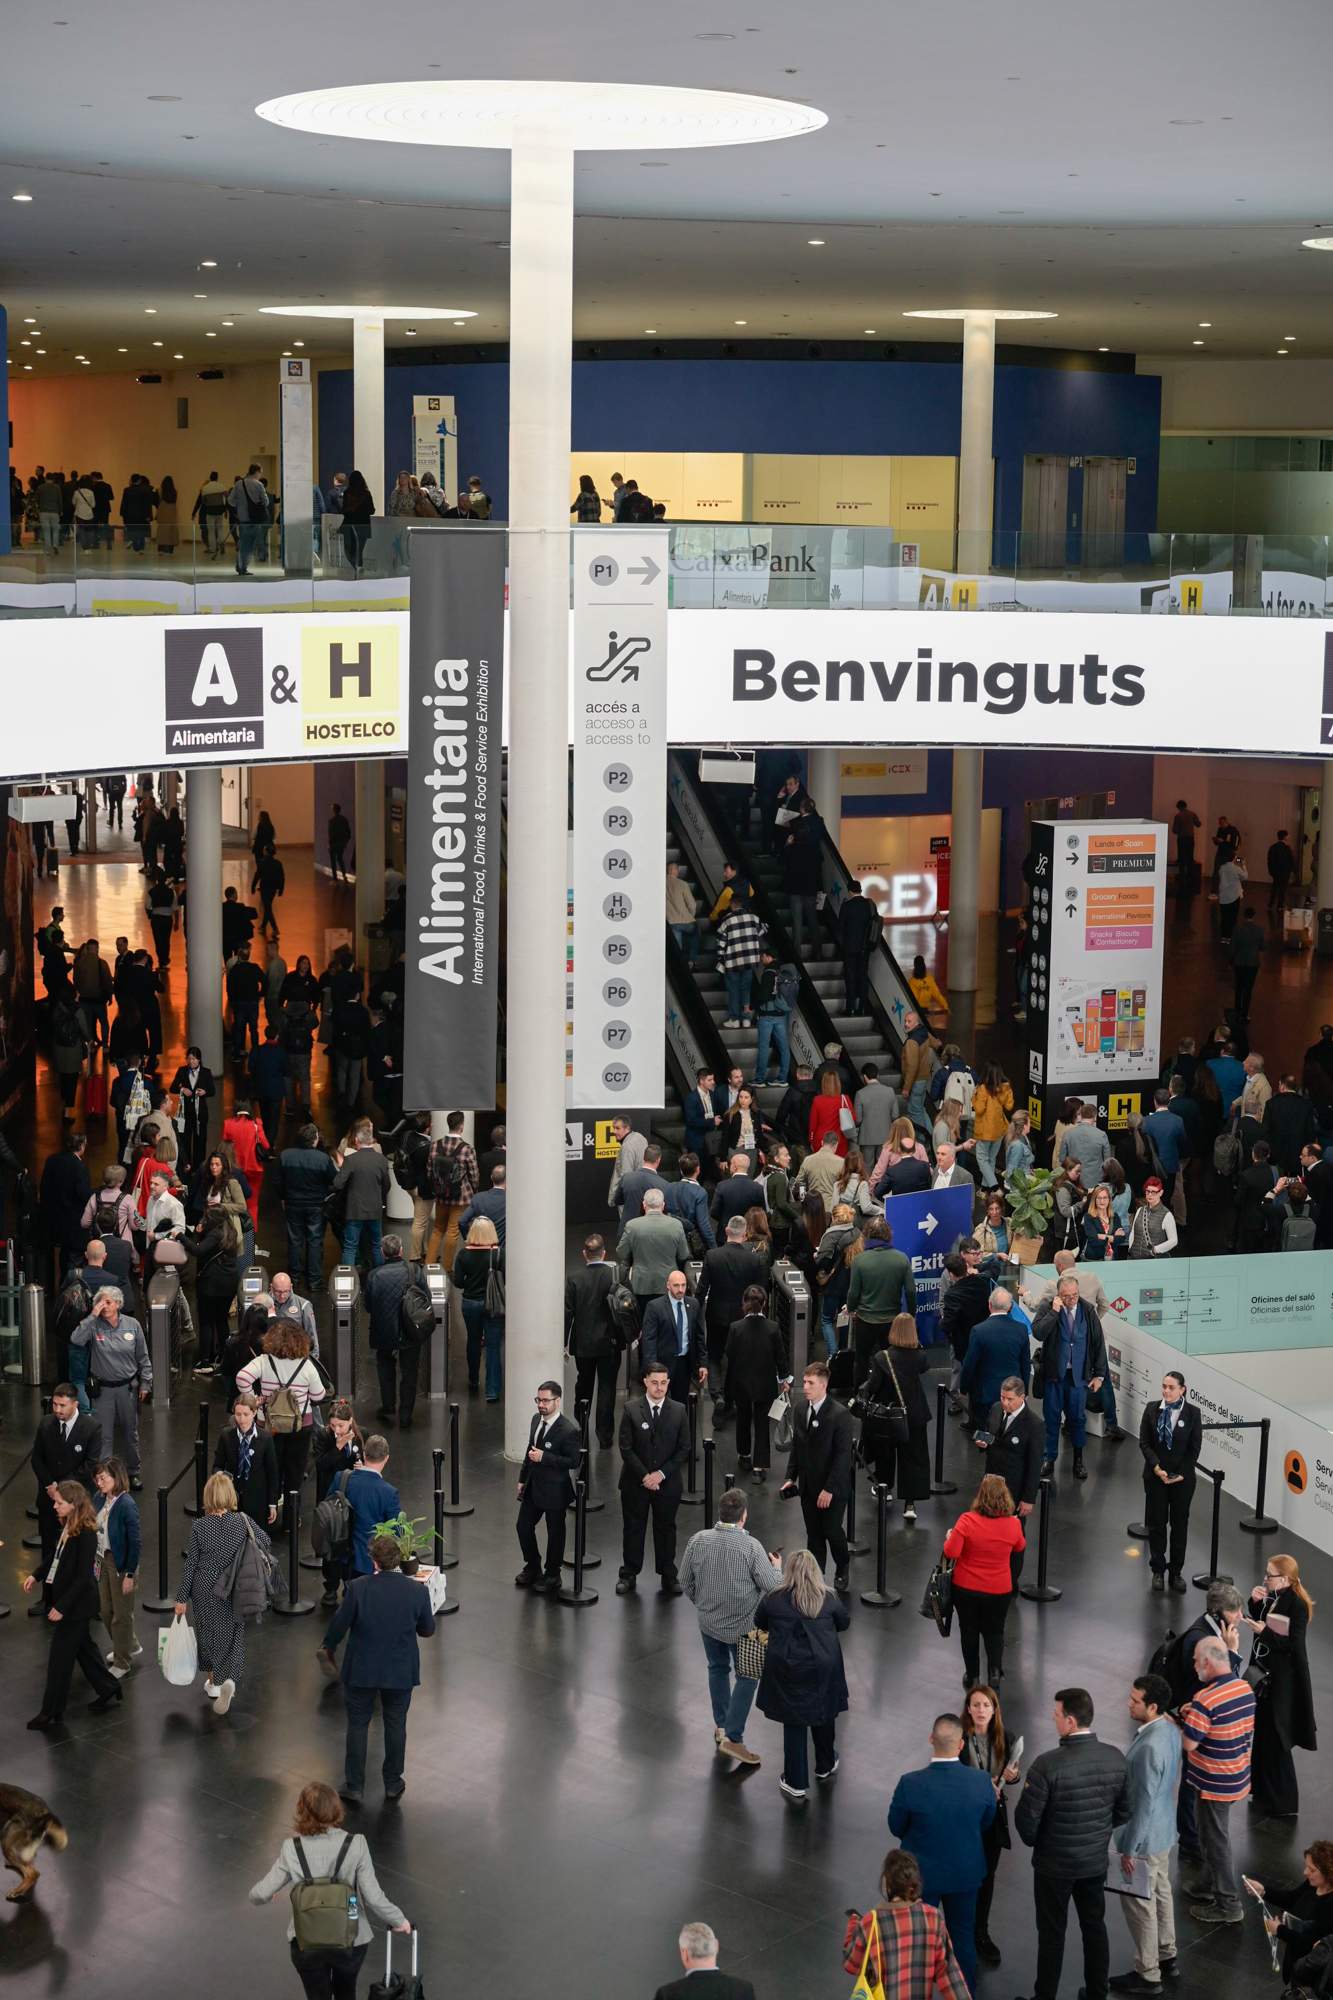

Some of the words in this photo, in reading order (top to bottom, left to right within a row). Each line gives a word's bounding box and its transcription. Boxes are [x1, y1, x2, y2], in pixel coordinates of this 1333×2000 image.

[594, 564, 612, 578] P1
[192, 642, 239, 707] A
[270, 664, 298, 705] &
[329, 642, 372, 699] H
[732, 647, 1145, 715] Benvinguts
[476, 659, 489, 722] Exhibition
[585, 699, 628, 714] accés
[631, 703, 641, 714] a
[306, 721, 396, 740] HOSTELCO
[585, 718, 635, 730] acceso
[639, 718, 648, 730] a
[172, 727, 256, 747] Alimentaria
[585, 734, 634, 746] access
[638, 733, 651, 746] to
[475, 725, 489, 773] Service
[608, 771, 629, 785] P2
[475, 775, 488, 809] Food
[418, 658, 470, 986] Alimentaria
[474, 811, 487, 821] &
[608, 814, 628, 828] P3
[473, 825, 487, 865] Drinks
[1124, 840, 1144, 848] Spain
[608, 857, 628, 871] P4
[1112, 858, 1153, 868] PREMIUM
[473, 869, 488, 904] Food,
[612, 895, 624, 907] H
[607, 907, 628, 919] 4-6
[472, 907, 486, 985] International
[607, 943, 627, 957] P5
[607, 986, 627, 999] P6
[607, 1028, 627, 1042] P7
[1033, 1055, 1039, 1072] A
[605, 1071, 629, 1083] CC7
[1031, 1101, 1038, 1118] H
[1098, 1105, 1108, 1118] &
[1117, 1098, 1132, 1116] H
[584, 1132, 595, 1147] &
[911, 1252, 945, 1273] Exit
[1251, 1296, 1284, 1304] Oficines
[1285, 1294, 1298, 1302] del
[1299, 1291, 1316, 1301] saló
[1250, 1306, 1281, 1315] Oficinas
[1282, 1304, 1294, 1313] del
[1295, 1303, 1315, 1312] salón
[1190, 1388, 1218, 1413] Oficines
[1218, 1404, 1229, 1419] del
